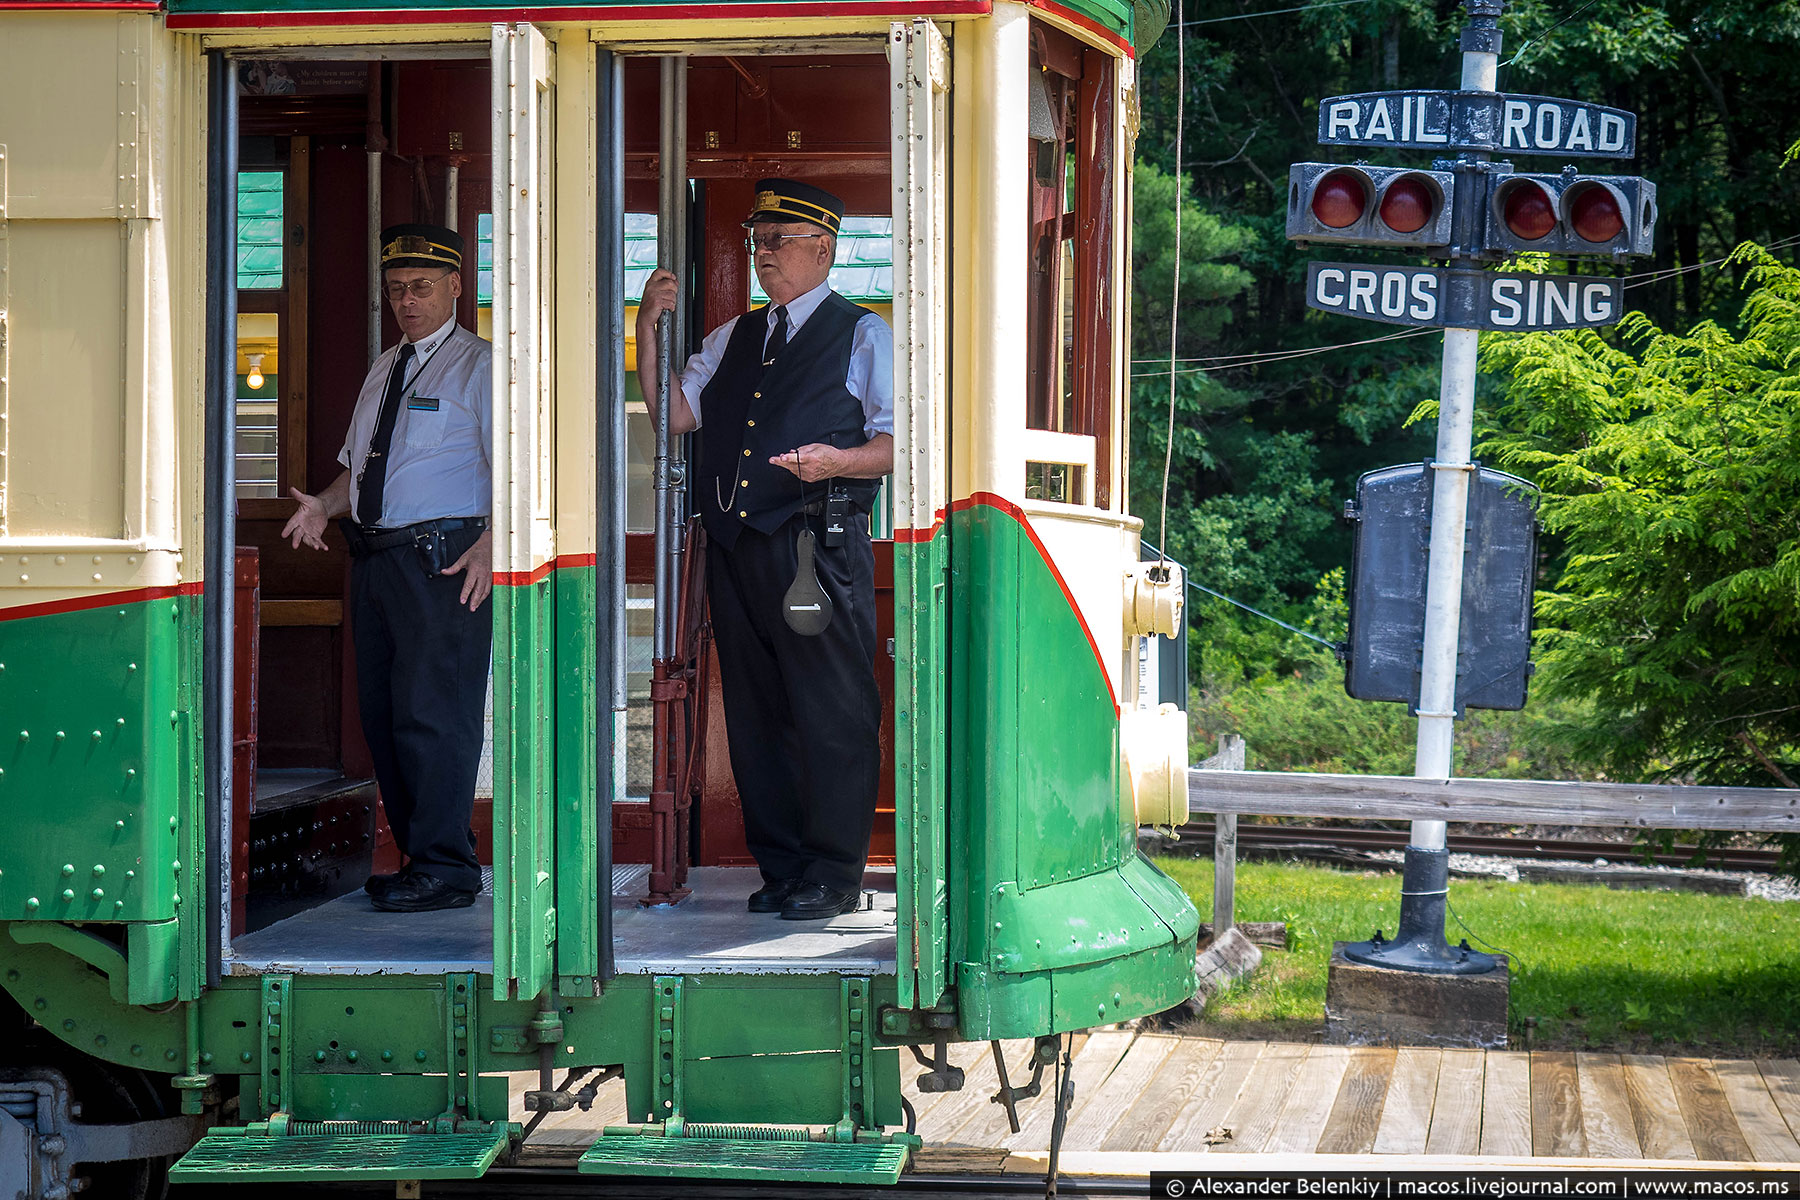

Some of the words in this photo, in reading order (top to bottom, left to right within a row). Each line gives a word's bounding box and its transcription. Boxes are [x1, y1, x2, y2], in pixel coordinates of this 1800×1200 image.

[312, 69, 338, 77] children
[1328, 96, 1447, 143] RAIL
[1502, 100, 1626, 152] ROAD
[1316, 268, 1438, 321] CROS
[1490, 278, 1612, 327] SING
